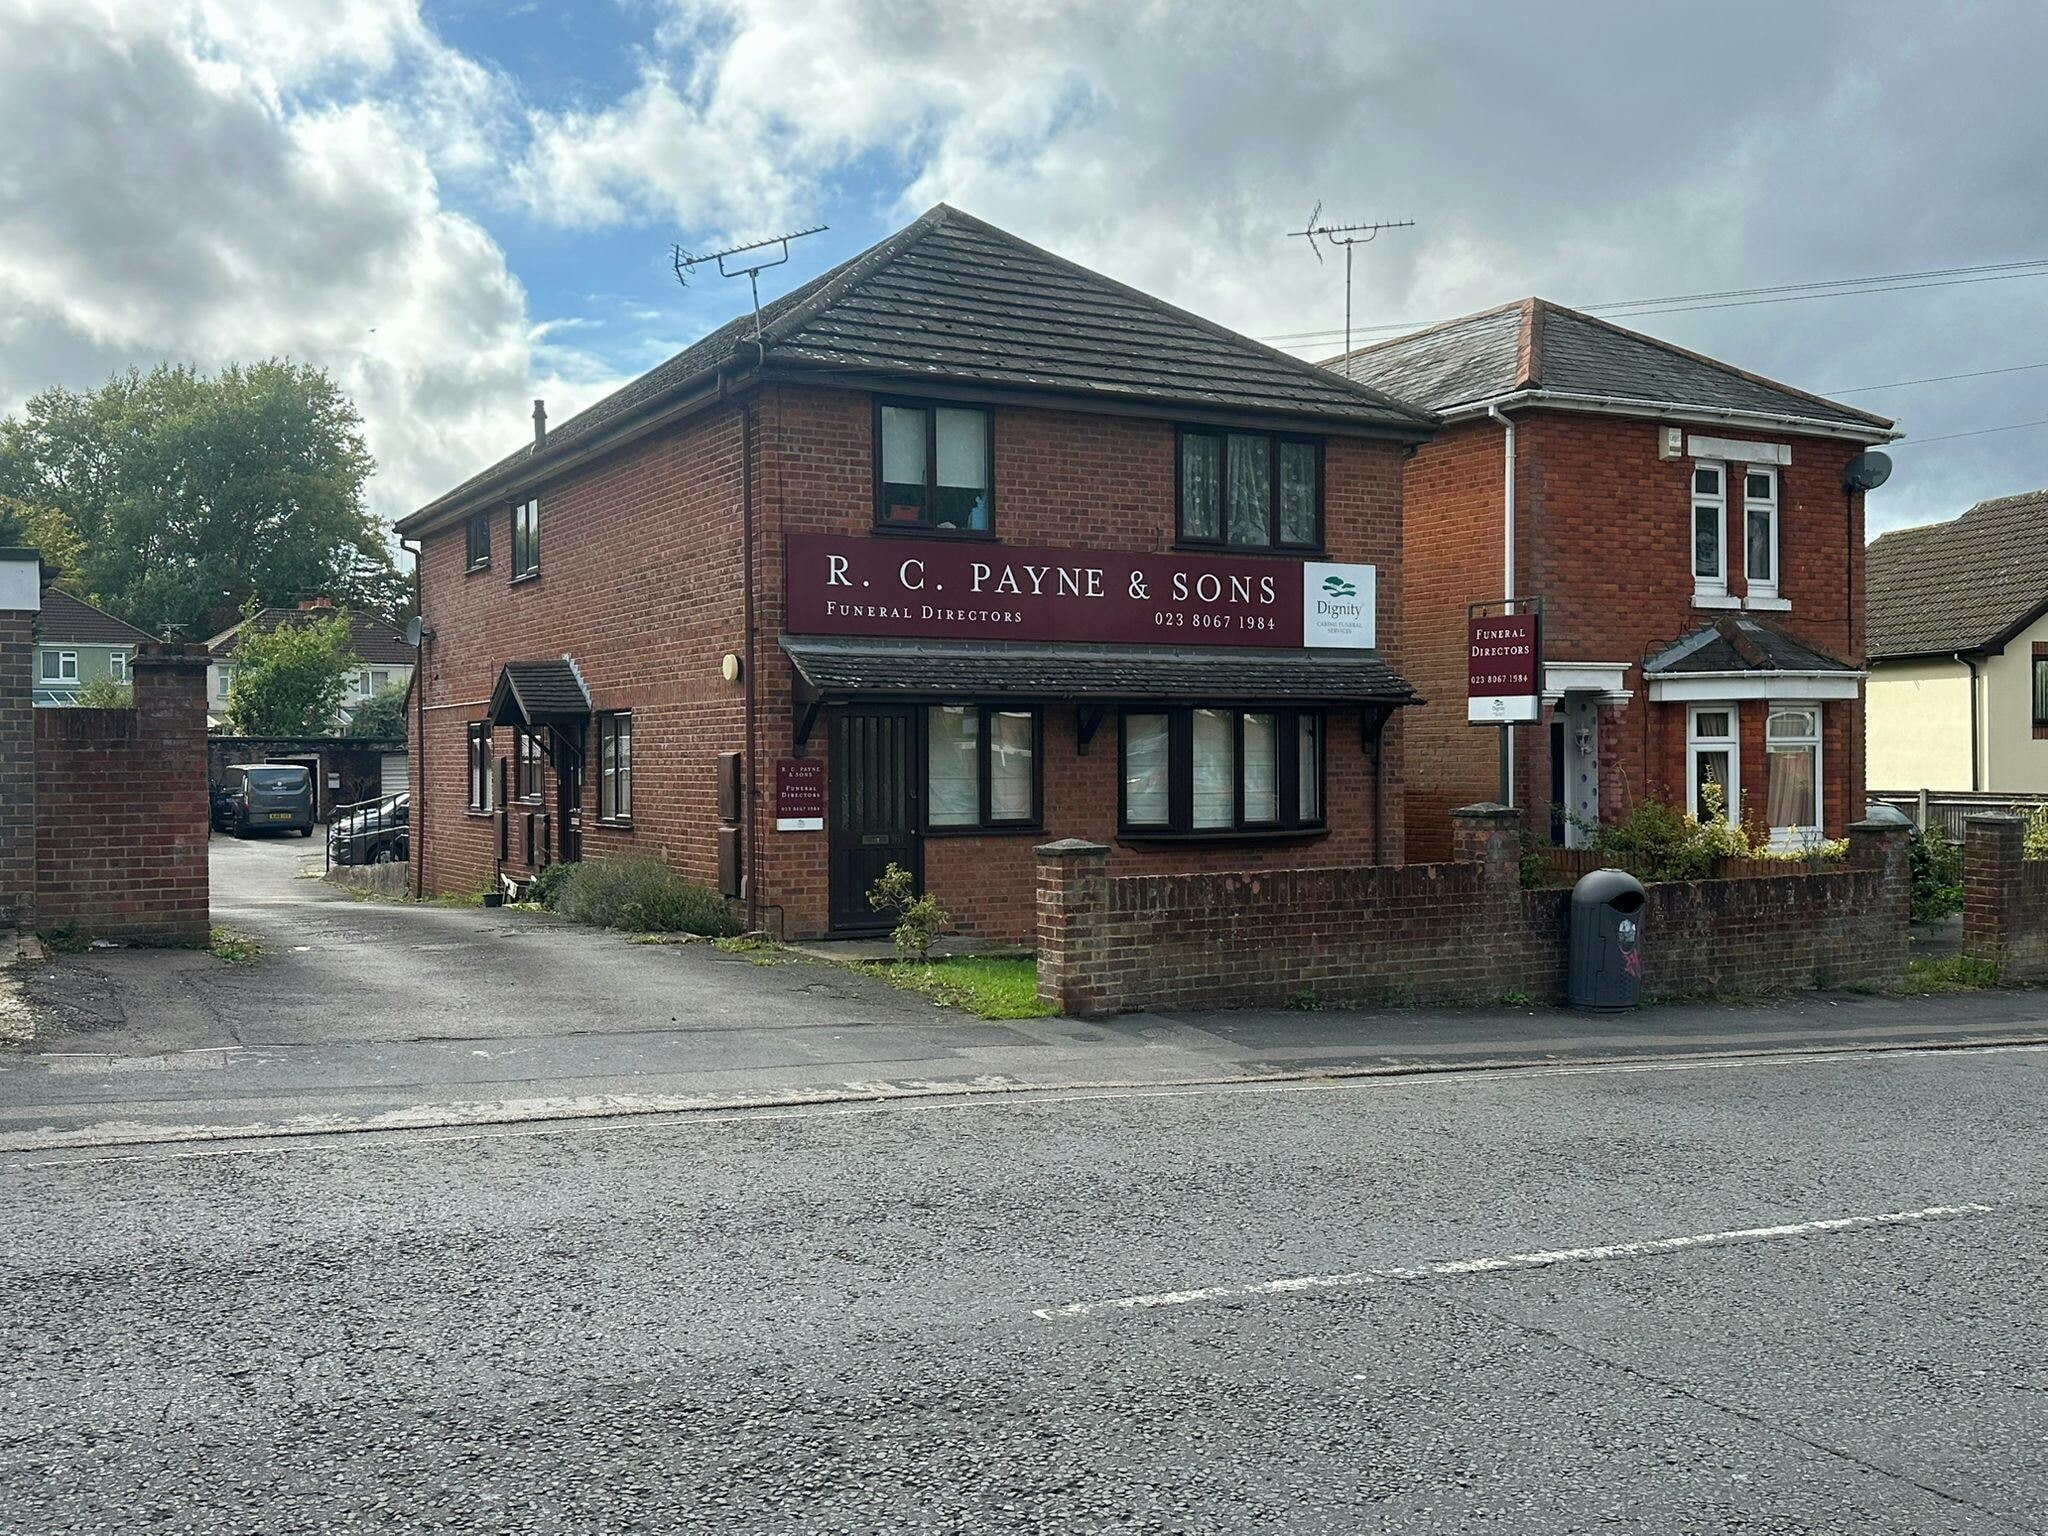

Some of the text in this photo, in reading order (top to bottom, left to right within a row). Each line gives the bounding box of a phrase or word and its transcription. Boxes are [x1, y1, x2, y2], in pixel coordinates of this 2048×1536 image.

[826, 554, 1276, 604] R. C. PAYNE & SONS
[826, 600, 1022, 623] FUNERAL DIRECTORS
[1316, 600, 1362, 620] Dignity
[1155, 611, 1276, 630] 023 8067 1984
[1476, 628, 1526, 640] FUNERAL
[1471, 645, 1530, 657] DIRECTORS
[1470, 674, 1528, 684] 023 8067 1984
